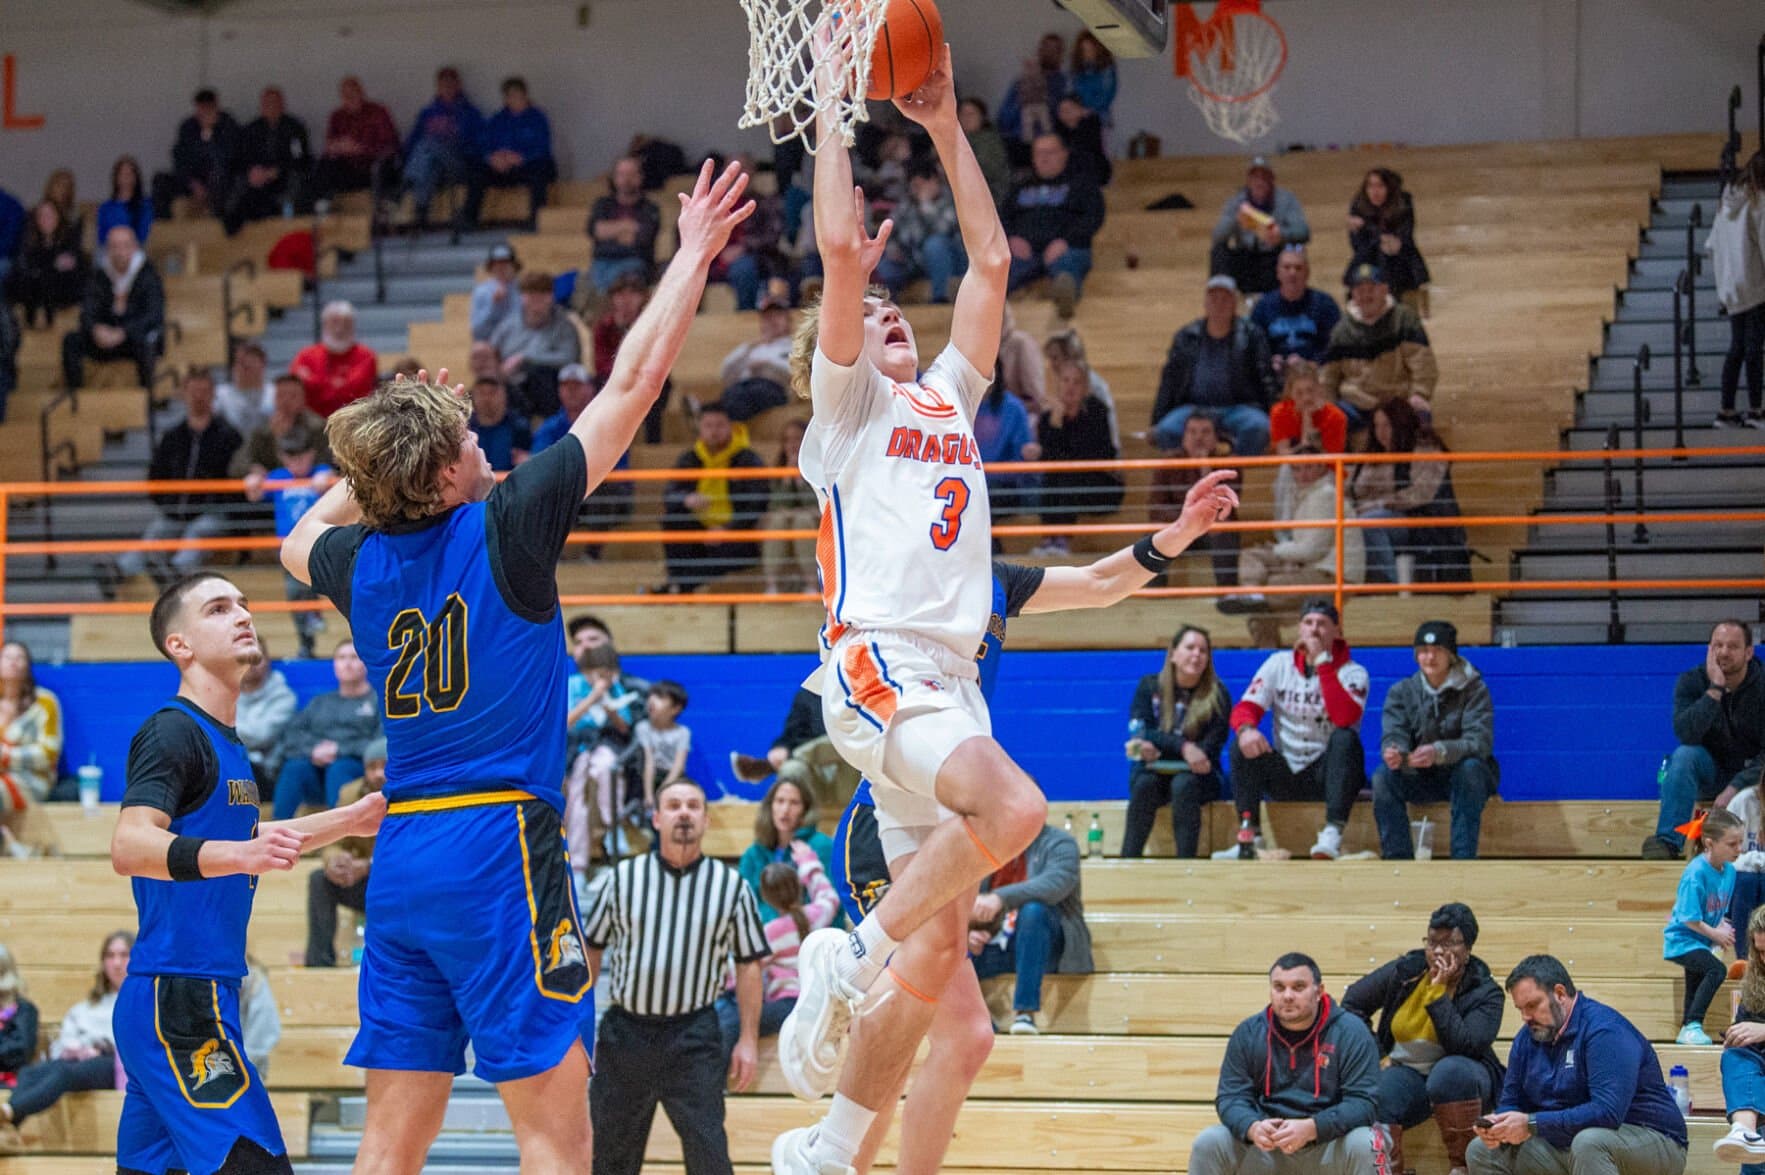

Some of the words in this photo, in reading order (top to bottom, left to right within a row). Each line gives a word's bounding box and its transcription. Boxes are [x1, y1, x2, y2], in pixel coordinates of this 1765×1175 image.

[3, 54, 46, 129] L
[930, 477, 971, 551] 3
[385, 591, 469, 718] 20
